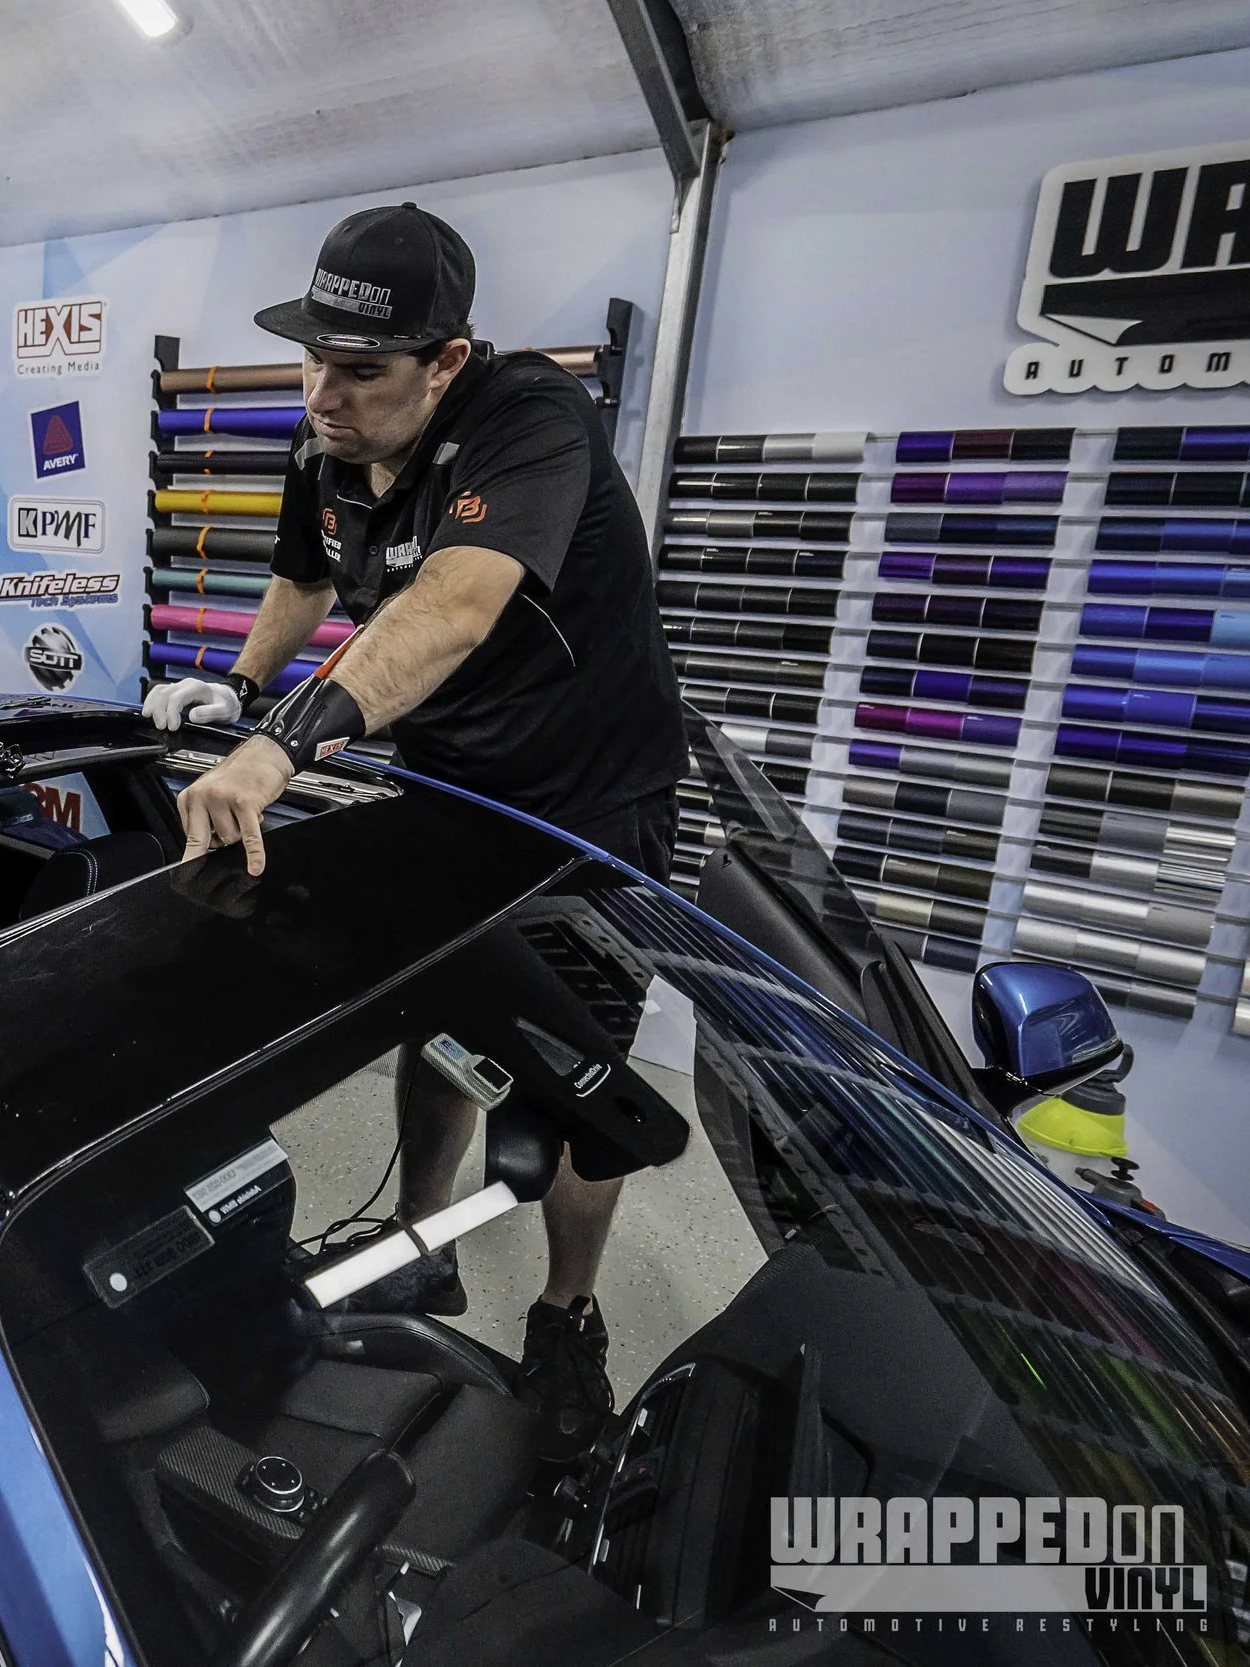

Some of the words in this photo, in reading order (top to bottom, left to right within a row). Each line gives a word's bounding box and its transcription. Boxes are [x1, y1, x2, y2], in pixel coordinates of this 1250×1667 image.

[17, 301, 102, 357] HEXIS
[17, 364, 62, 375] Creating
[68, 361, 100, 372] Media
[43, 454, 78, 470] AVERY
[18, 508, 96, 547] KPMF
[29, 649, 79, 669] SOTT
